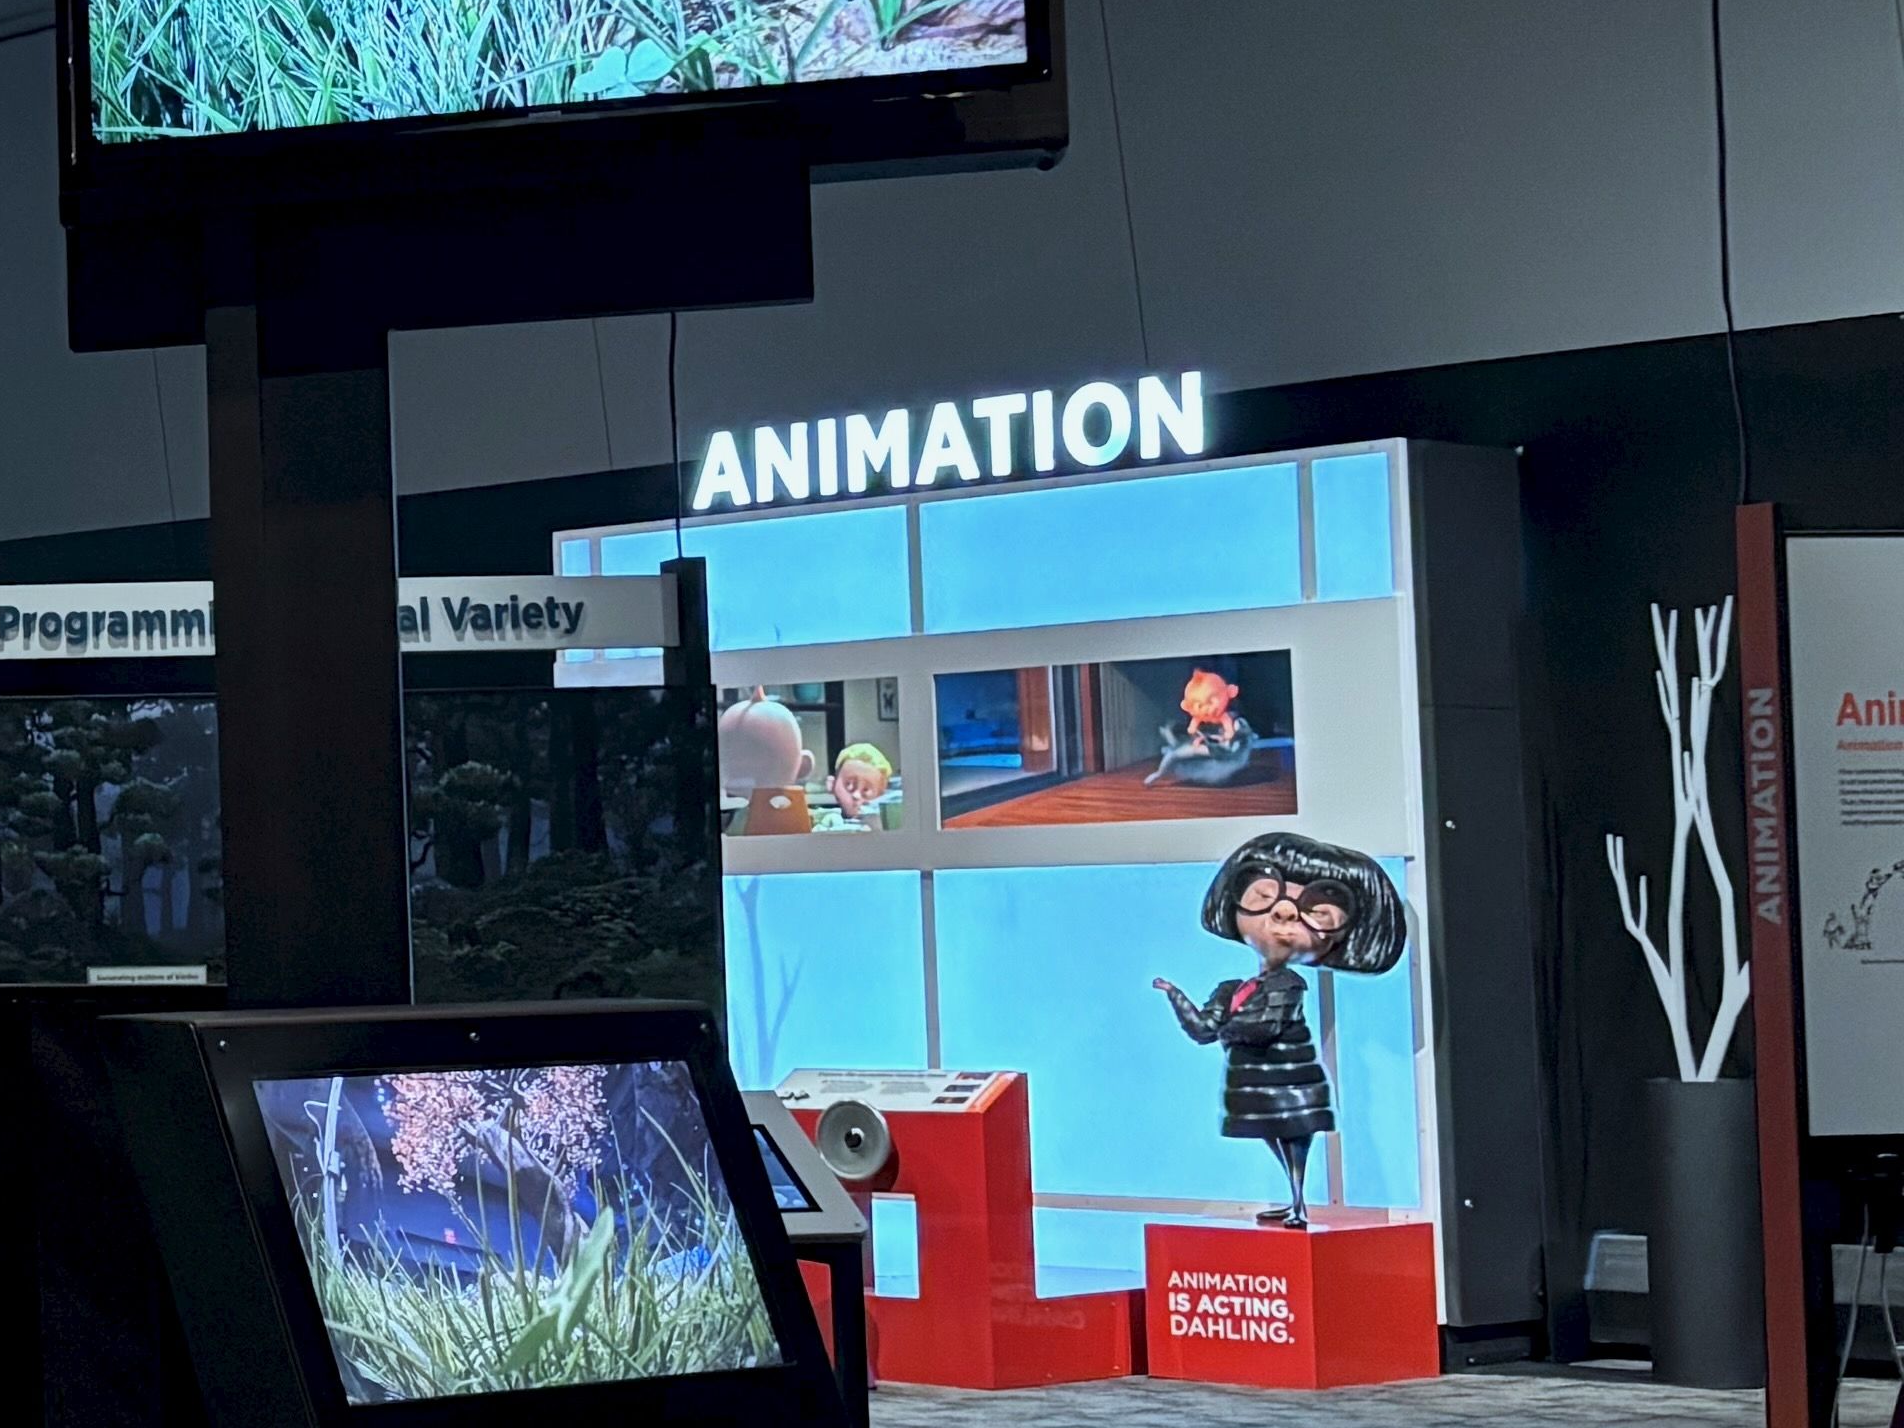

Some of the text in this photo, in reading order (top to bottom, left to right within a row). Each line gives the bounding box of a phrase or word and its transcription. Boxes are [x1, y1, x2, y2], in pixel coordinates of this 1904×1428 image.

[692, 370, 1205, 511] ANIMATION
[441, 594, 585, 635] Variety
[1749, 687, 1782, 924] ANIMATION
[1167, 1270, 1288, 1296] ANIMATION
[1168, 1291, 1295, 1323] IS ACTING,
[1169, 1314, 1295, 1344] DAHLING.
